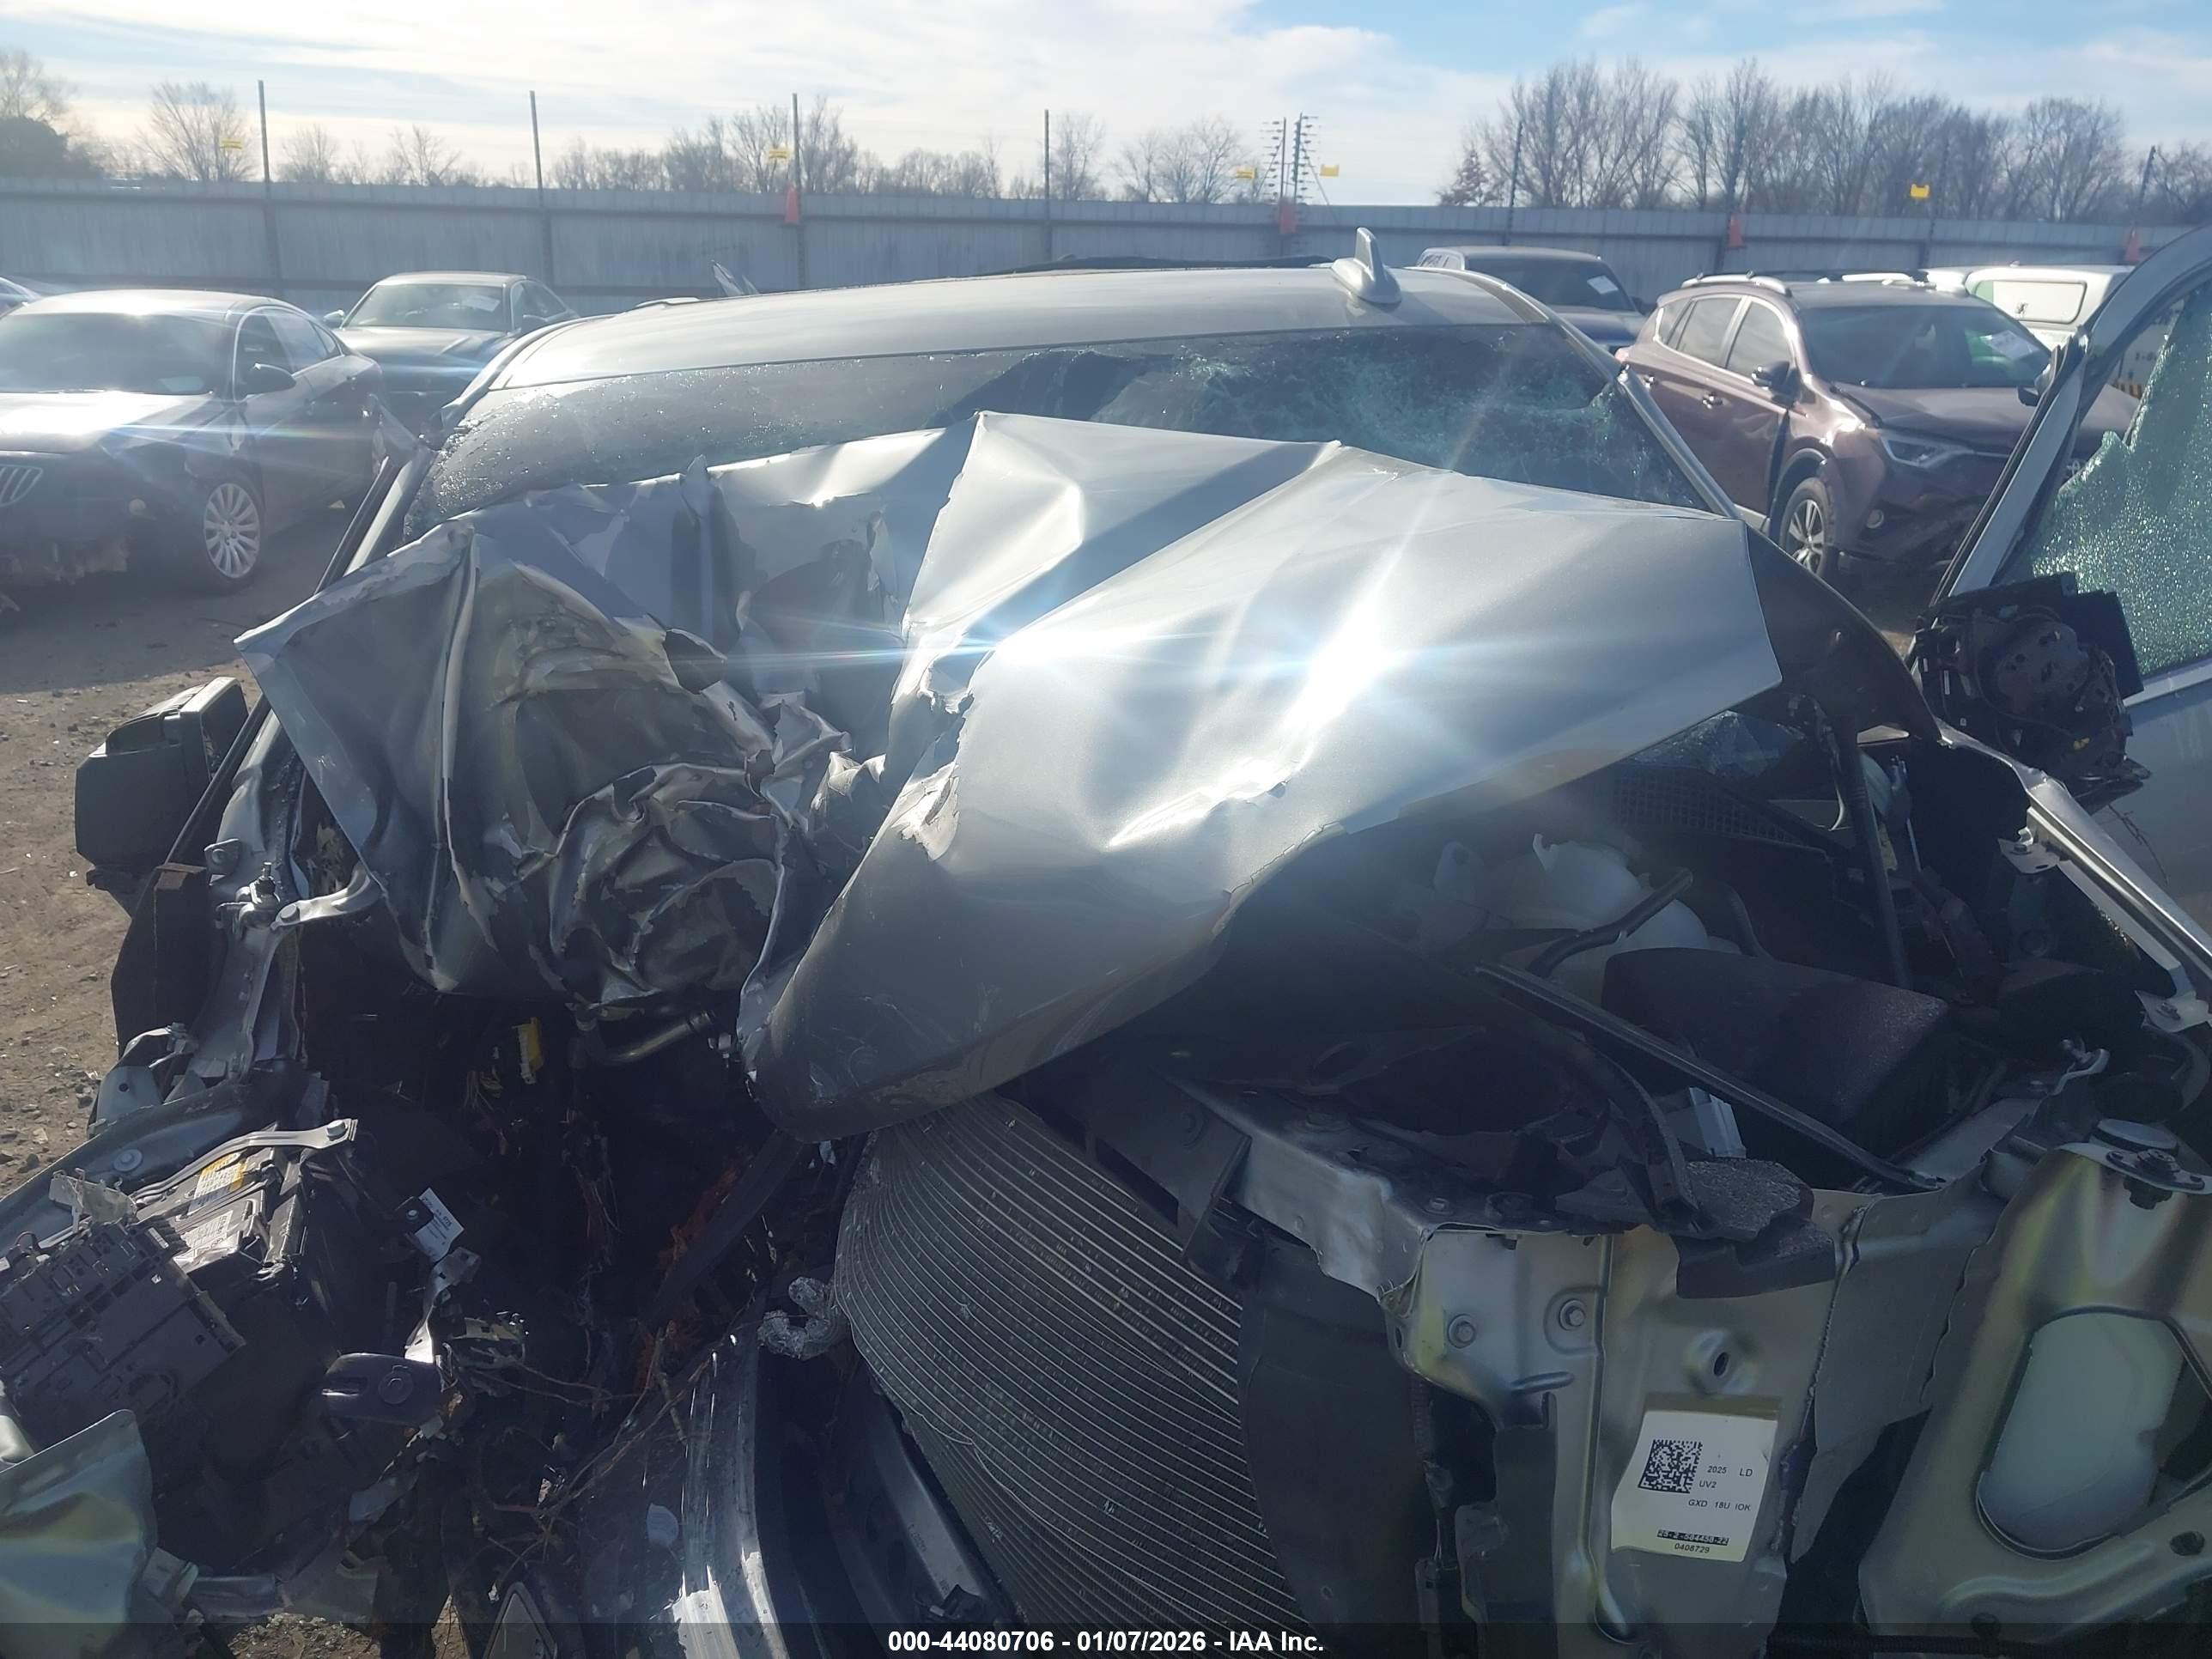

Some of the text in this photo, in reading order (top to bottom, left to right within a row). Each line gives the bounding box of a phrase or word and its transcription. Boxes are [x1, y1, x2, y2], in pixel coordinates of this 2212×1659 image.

[1707, 1465, 1753, 1477] 2025 LD
[1698, 1480, 1717, 1489] UV2
[1688, 1498, 1708, 1508] GXD
